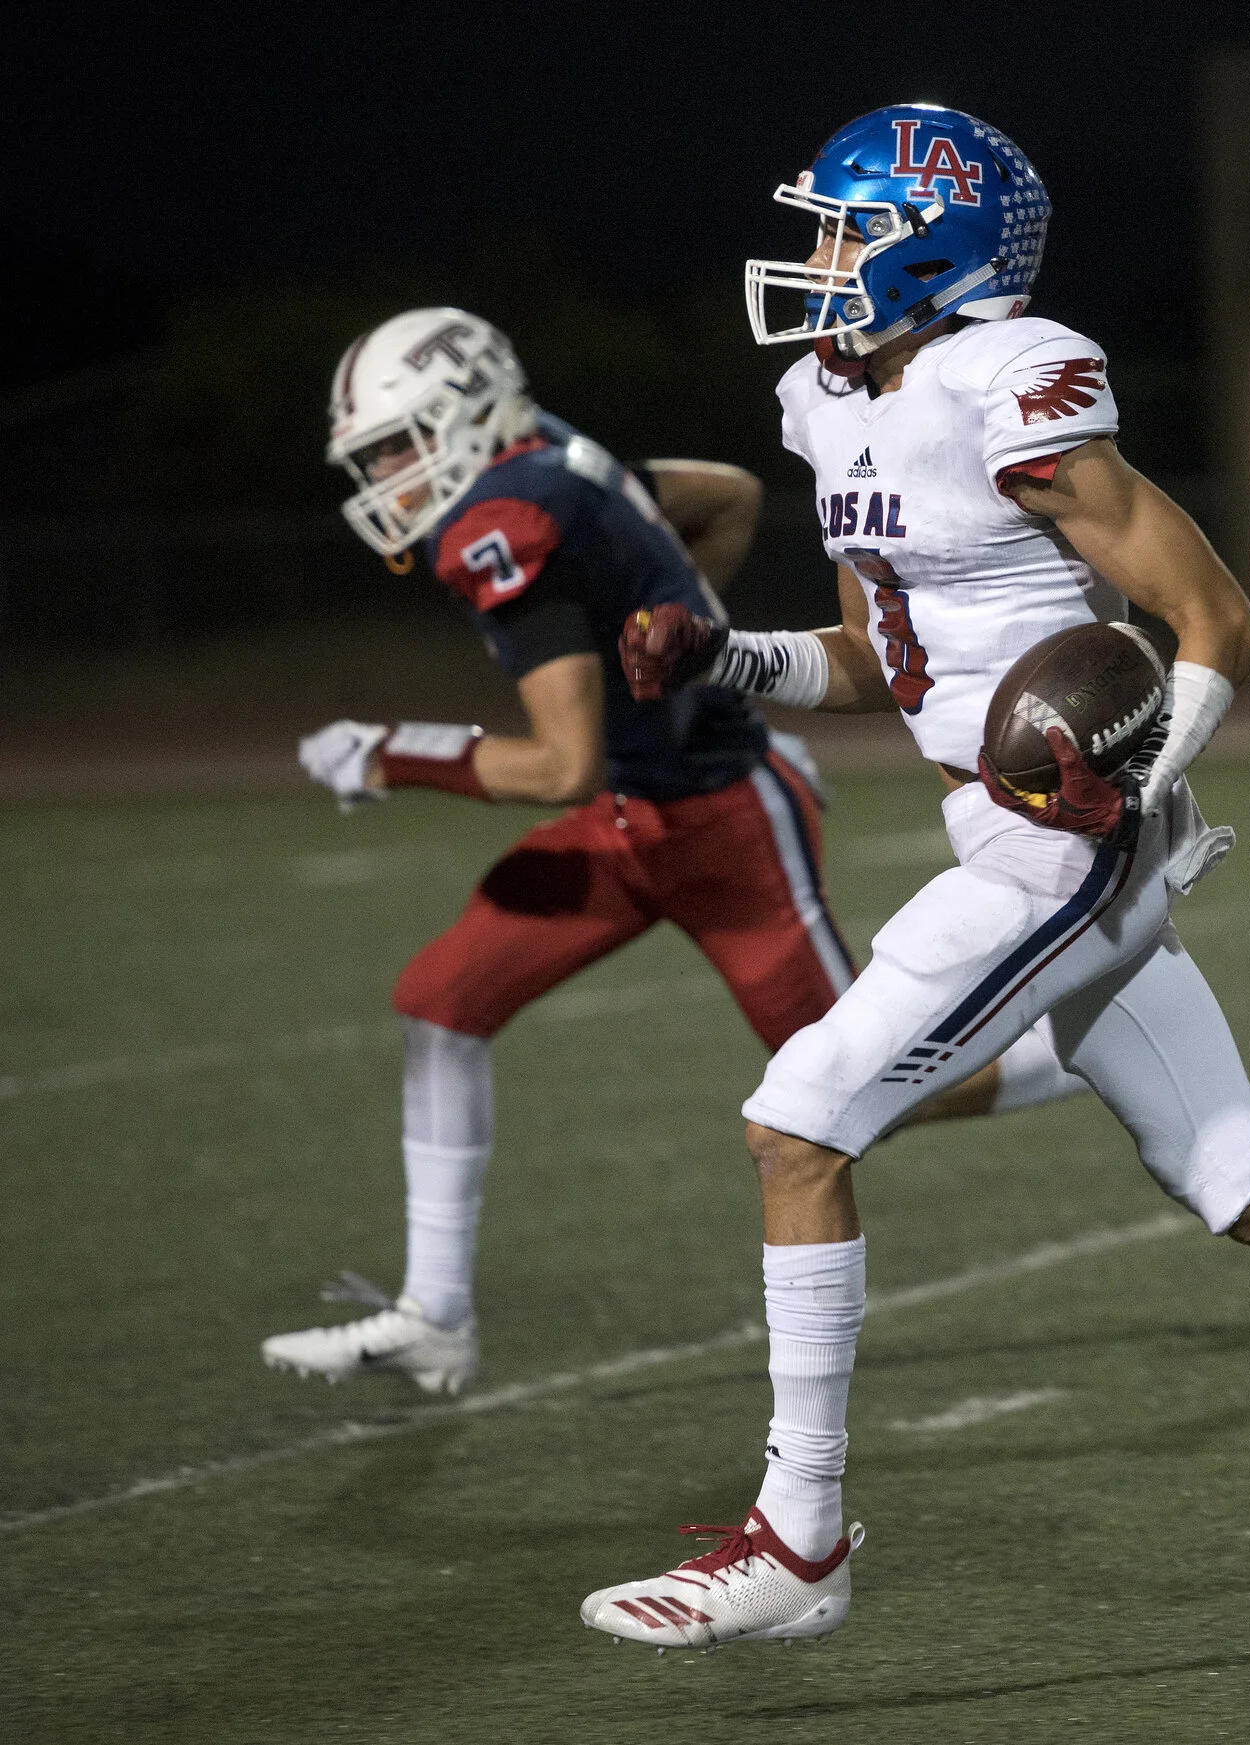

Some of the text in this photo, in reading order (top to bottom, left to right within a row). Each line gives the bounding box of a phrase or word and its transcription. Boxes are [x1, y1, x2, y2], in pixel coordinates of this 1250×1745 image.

[889, 119, 983, 208] LA
[847, 465, 877, 479] adidas
[863, 491, 907, 538] AL
[461, 529, 526, 594] 7
